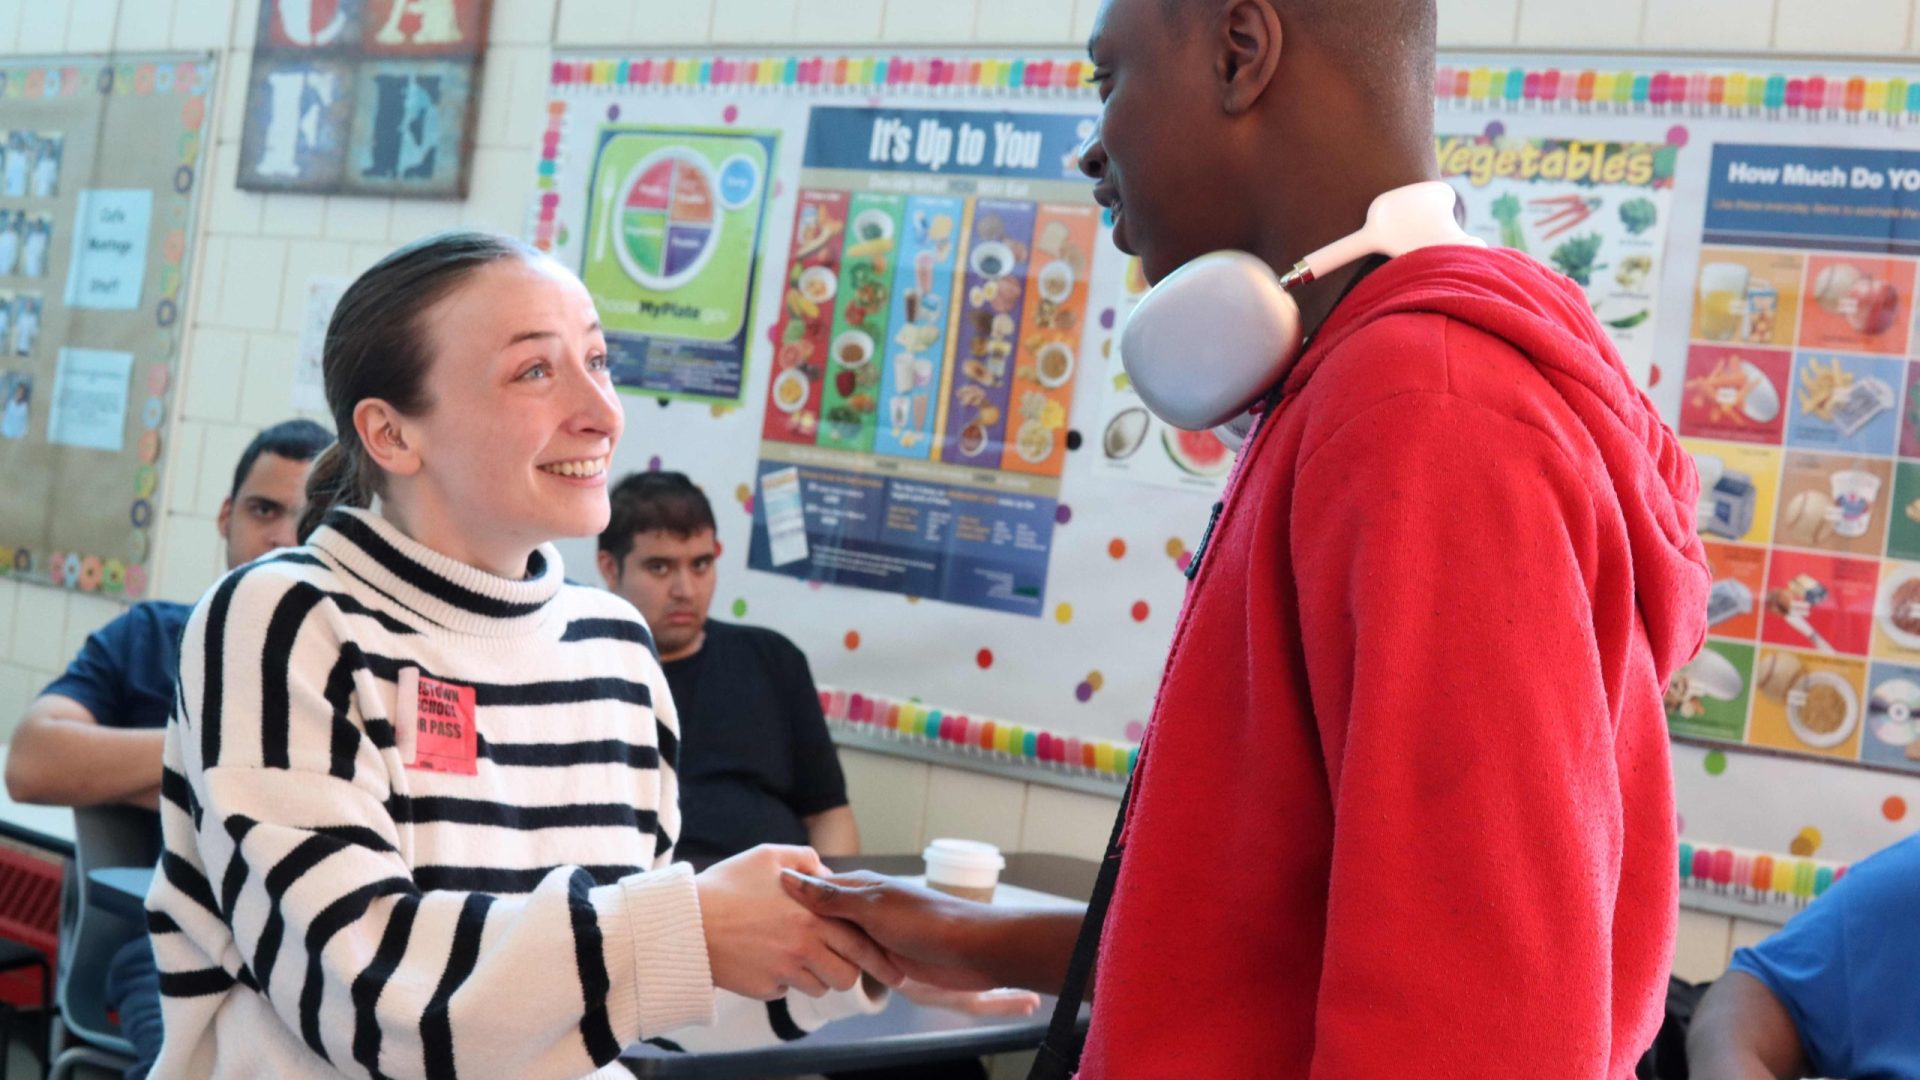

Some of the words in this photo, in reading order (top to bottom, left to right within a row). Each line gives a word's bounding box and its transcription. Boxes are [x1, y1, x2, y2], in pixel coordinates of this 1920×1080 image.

[868, 117, 912, 163] It's
[915, 118, 954, 171] Up
[956, 122, 986, 166] to
[993, 121, 1042, 168] You
[1434, 139, 1654, 187] Vegetables
[1728, 161, 1780, 184] How
[1782, 162, 1847, 188] Much
[1850, 166, 1885, 190] Do
[1888, 168, 1920, 192] YO
[430, 719, 462, 740] PASS
